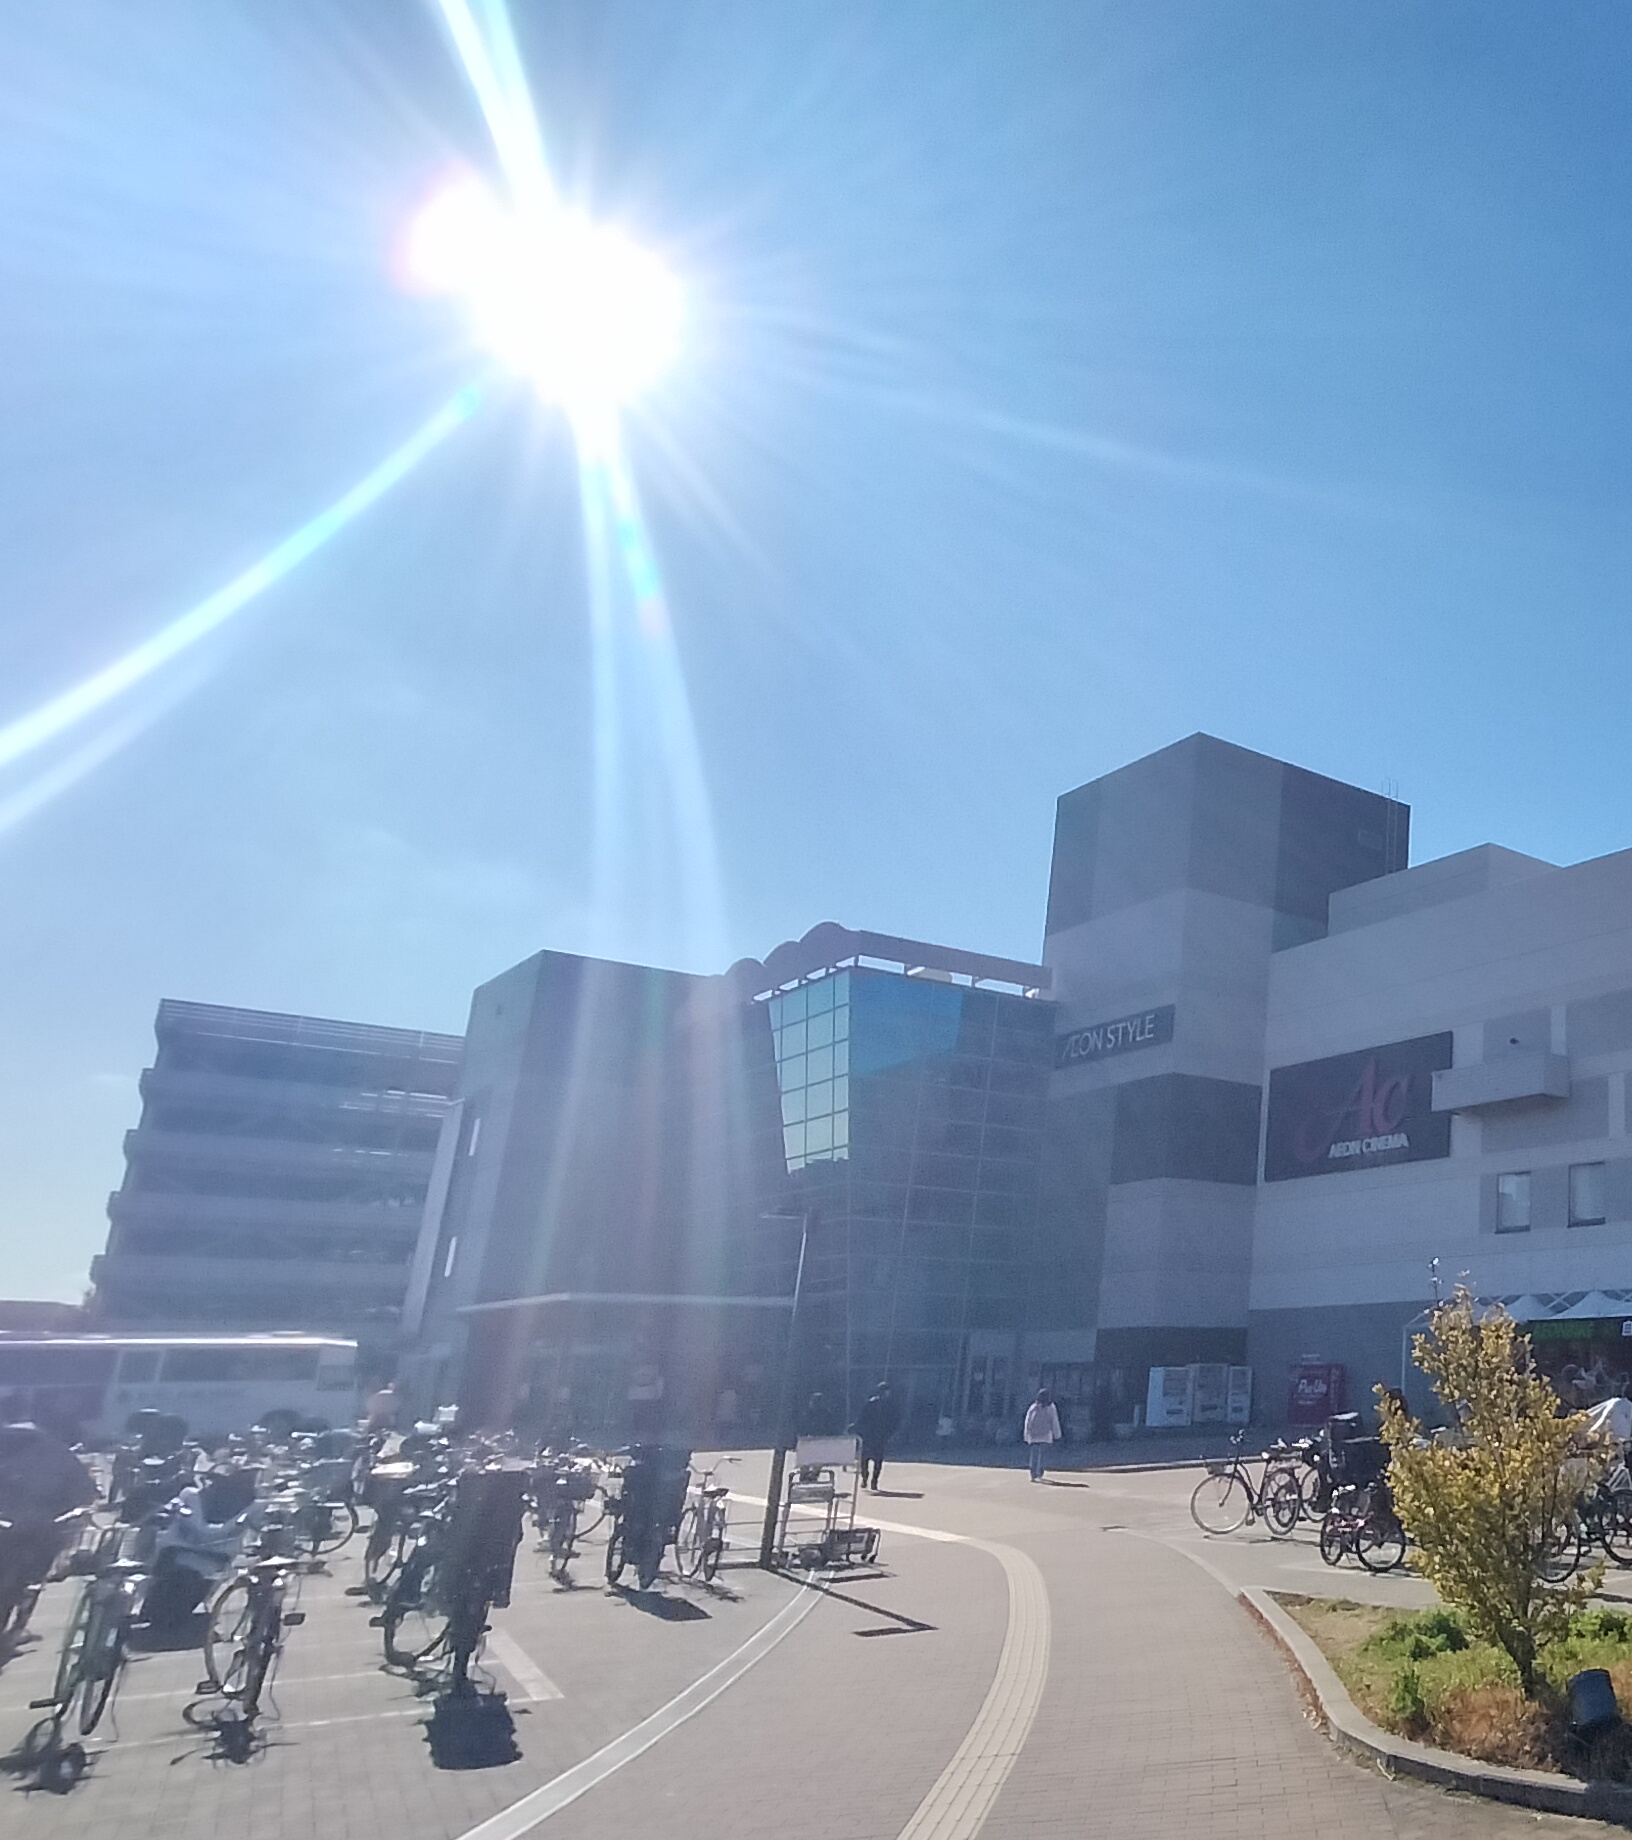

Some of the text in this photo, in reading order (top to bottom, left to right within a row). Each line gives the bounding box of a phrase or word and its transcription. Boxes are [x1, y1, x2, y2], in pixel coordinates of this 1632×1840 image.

[1107, 1015, 1154, 1049] STYLE
[1328, 1133, 1408, 1159] AEON CINEMA
